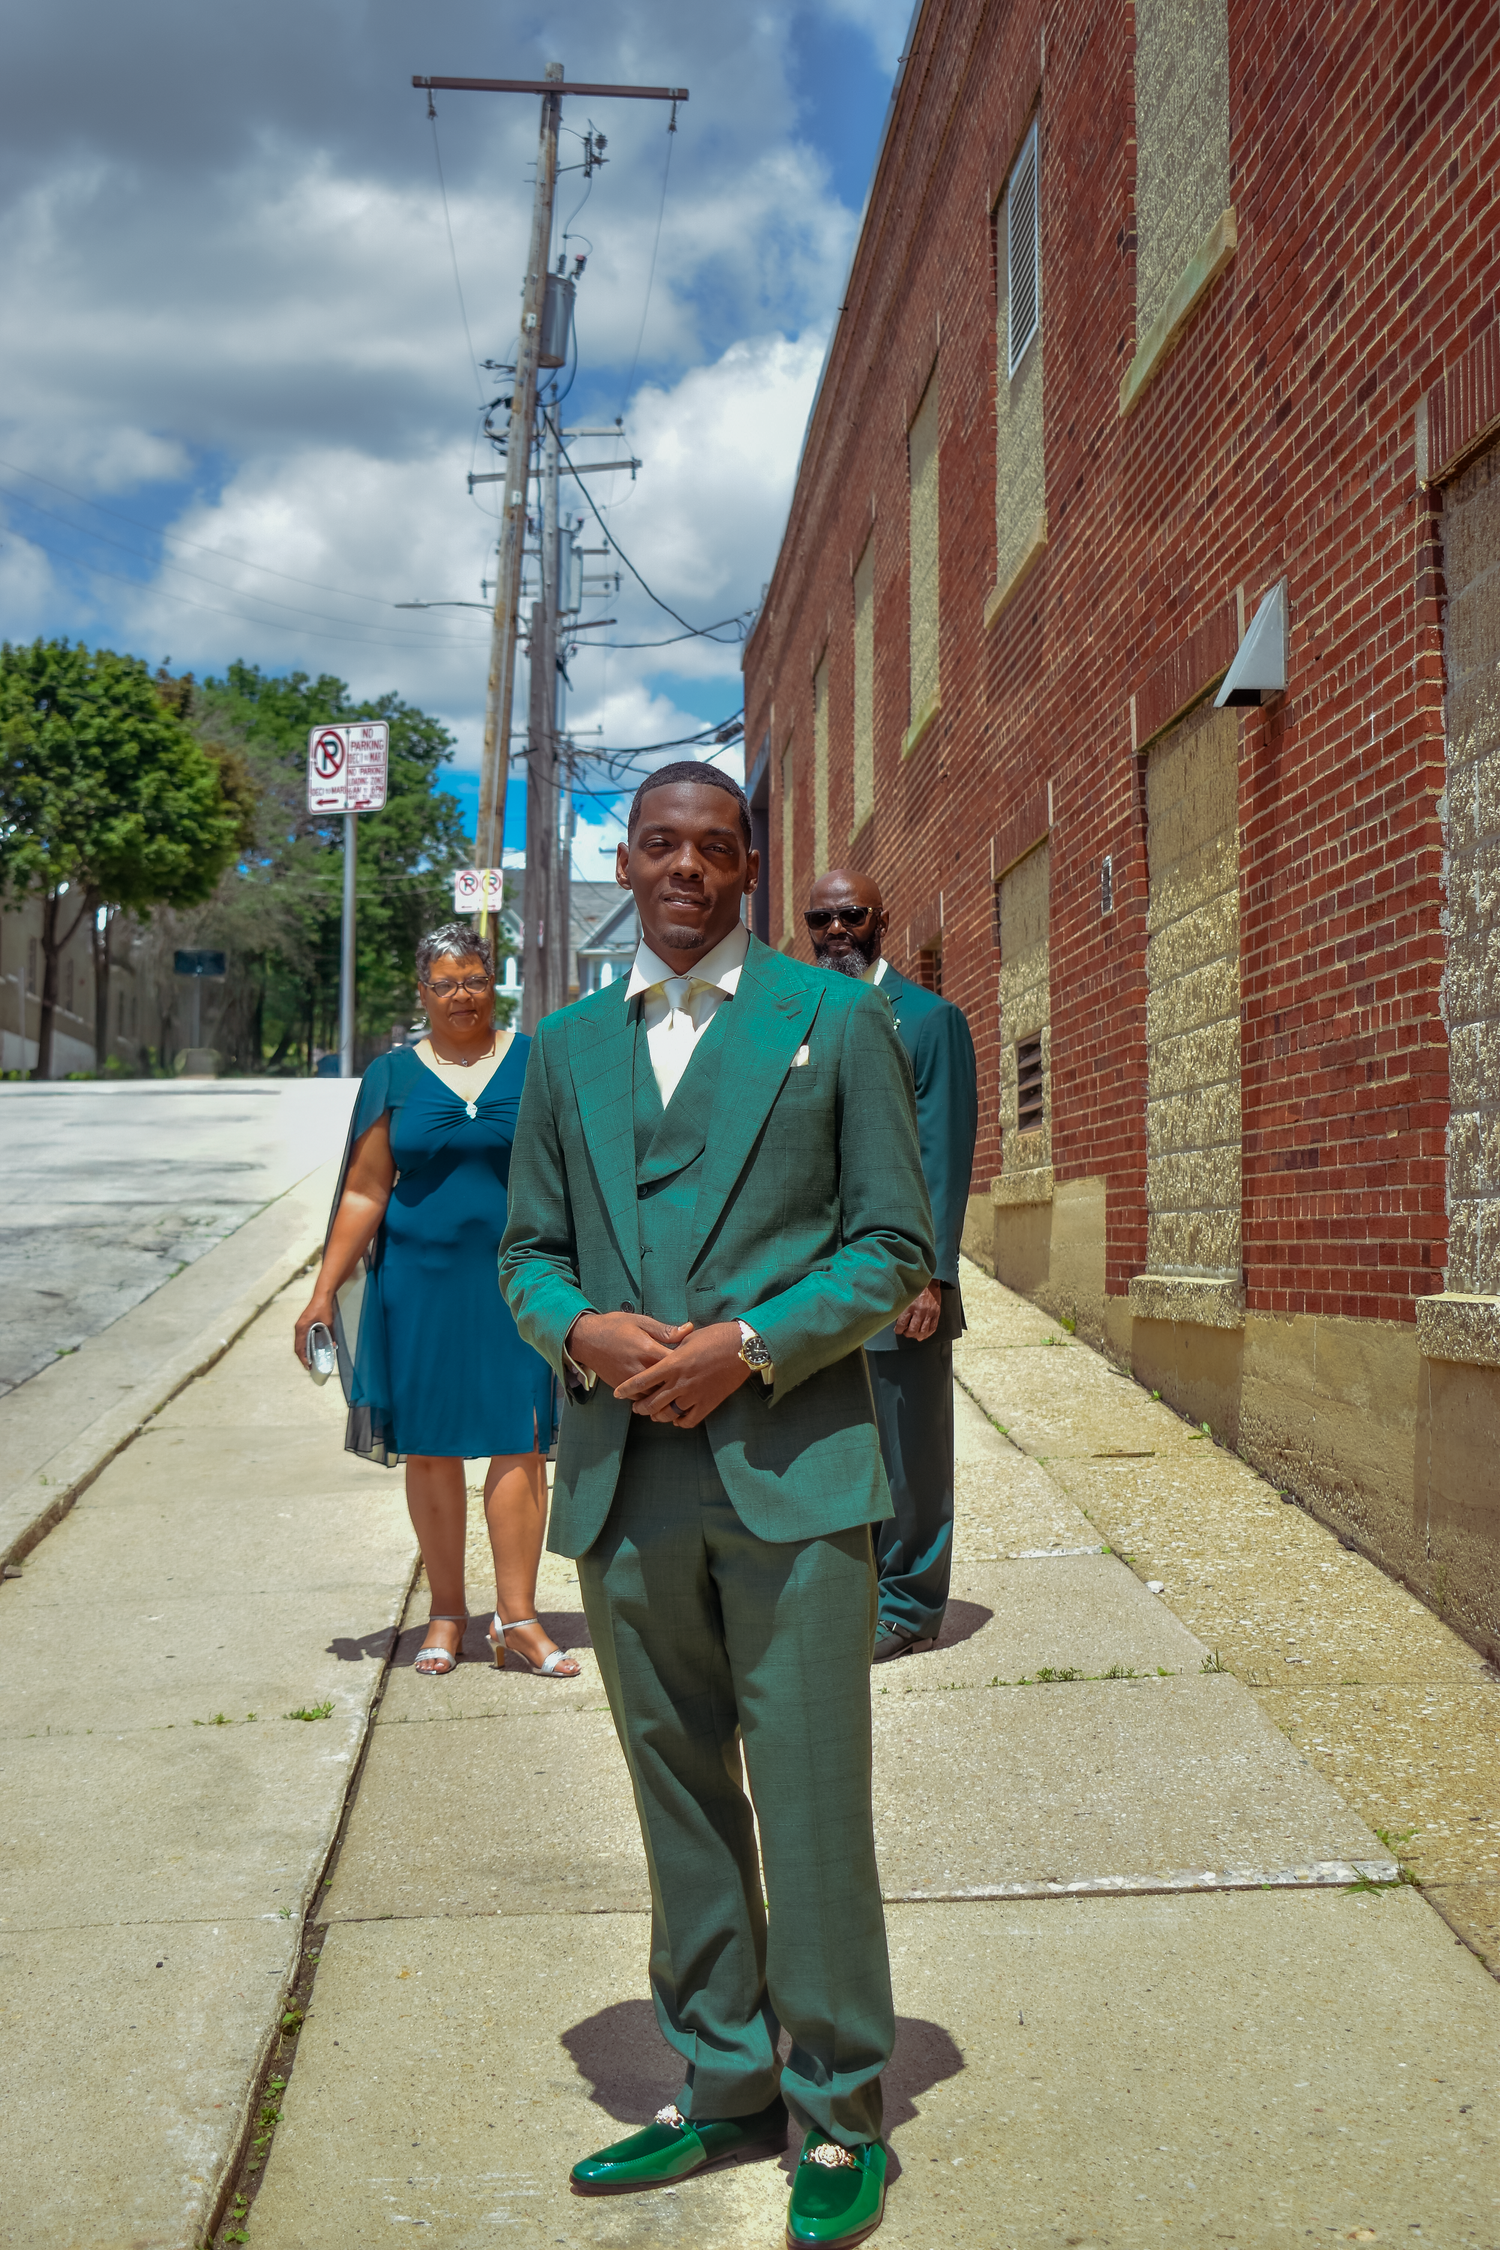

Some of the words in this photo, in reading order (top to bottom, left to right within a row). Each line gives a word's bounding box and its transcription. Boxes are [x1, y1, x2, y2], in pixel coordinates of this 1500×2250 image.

[363, 728, 373, 738] NO
[351, 740, 384, 751] PARKING
[348, 768, 356, 776] NO
[349, 778, 368, 786] LOADING
[371, 777, 384, 785] ZONE
